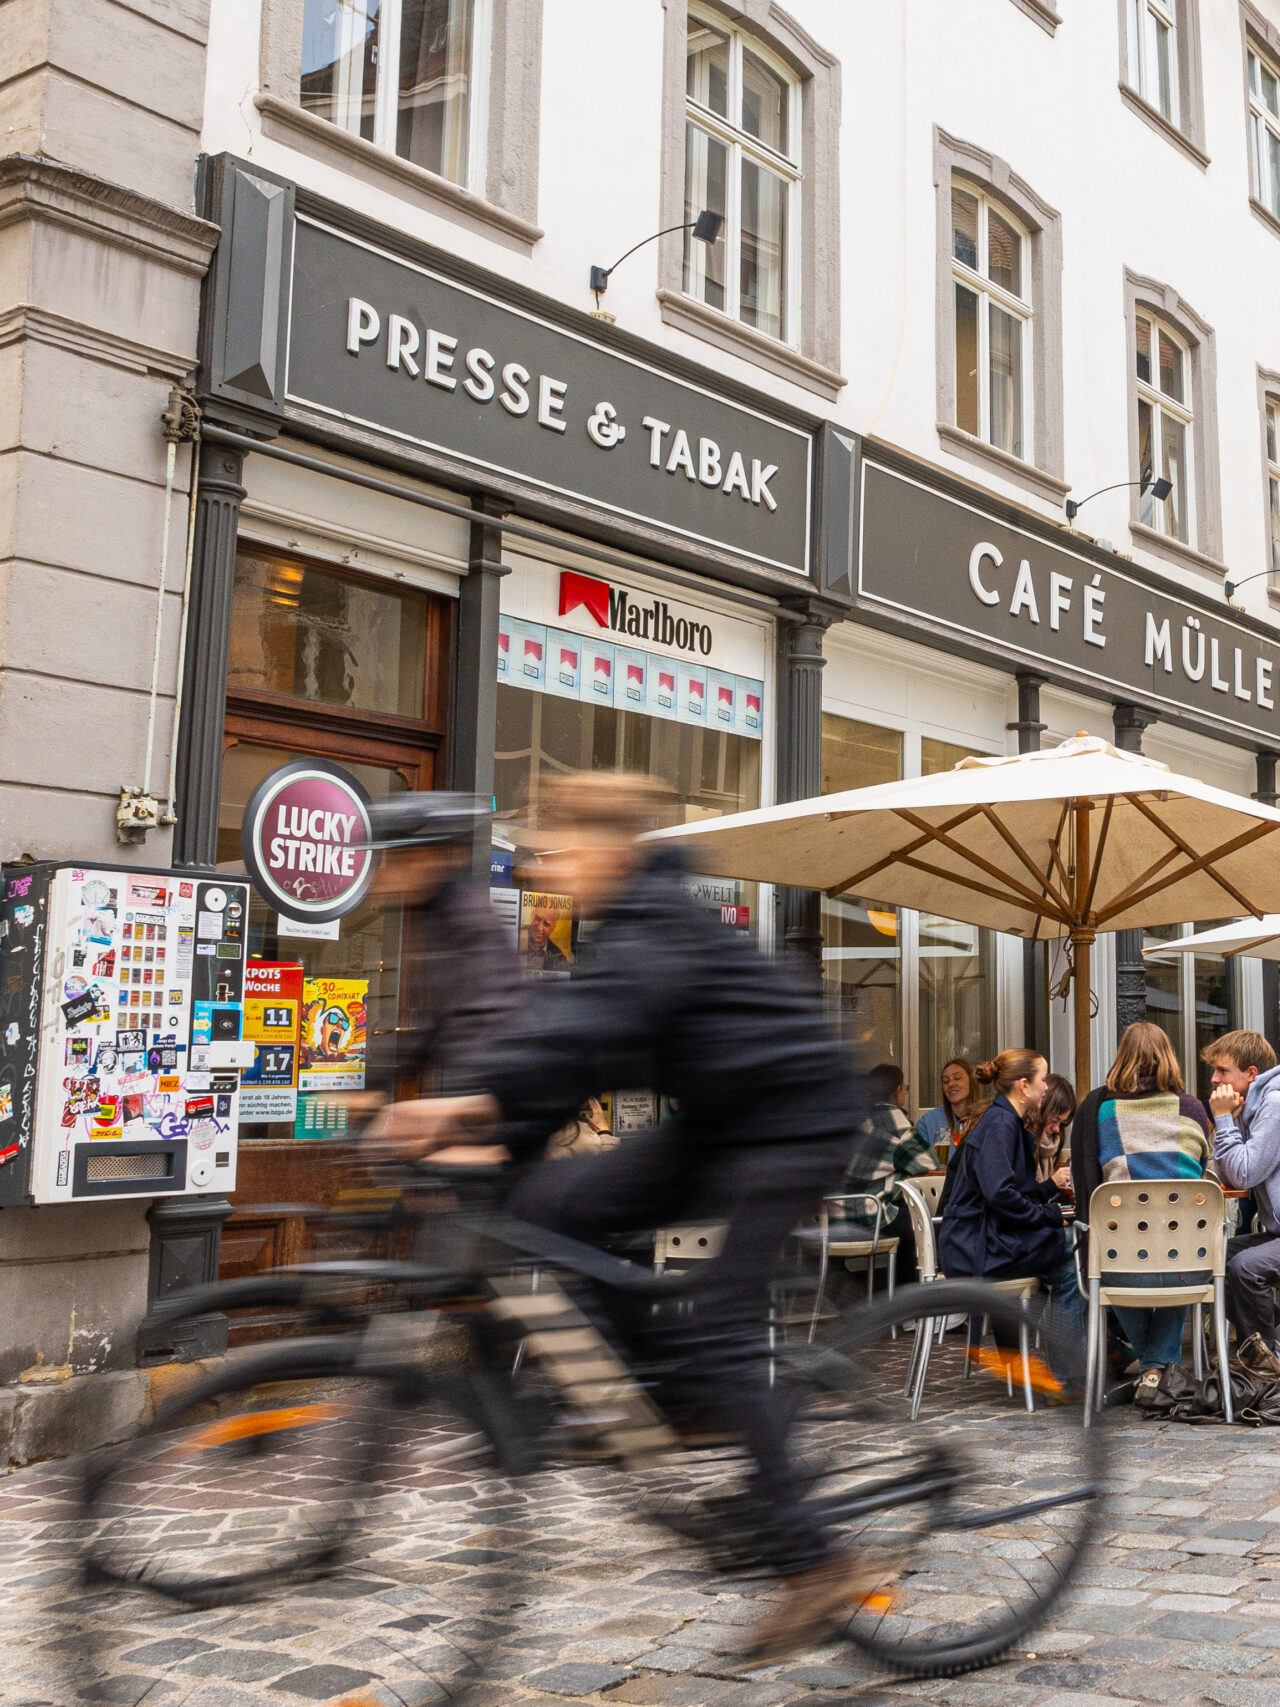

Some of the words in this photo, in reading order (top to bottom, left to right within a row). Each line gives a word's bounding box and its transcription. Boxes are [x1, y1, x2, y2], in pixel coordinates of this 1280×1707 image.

[346, 297, 568, 432] PRESSE
[587, 402, 626, 447] &
[642, 416, 779, 511] TABAK
[969, 542, 1107, 647] CAFÉ
[607, 587, 713, 656] Marlboro
[277, 804, 357, 844] LUCKY
[270, 837, 356, 877] STRIKE
[523, 893, 548, 909] BRUNO
[548, 895, 572, 911] JONAS
[702, 884, 734, 903] WELT
[721, 905, 737, 925] IVO
[322, 981, 336, 995] 30
[266, 1008, 290, 1026] 11
[265, 1053, 291, 1071] 17
[160, 1080, 178, 1088] MIEZ
